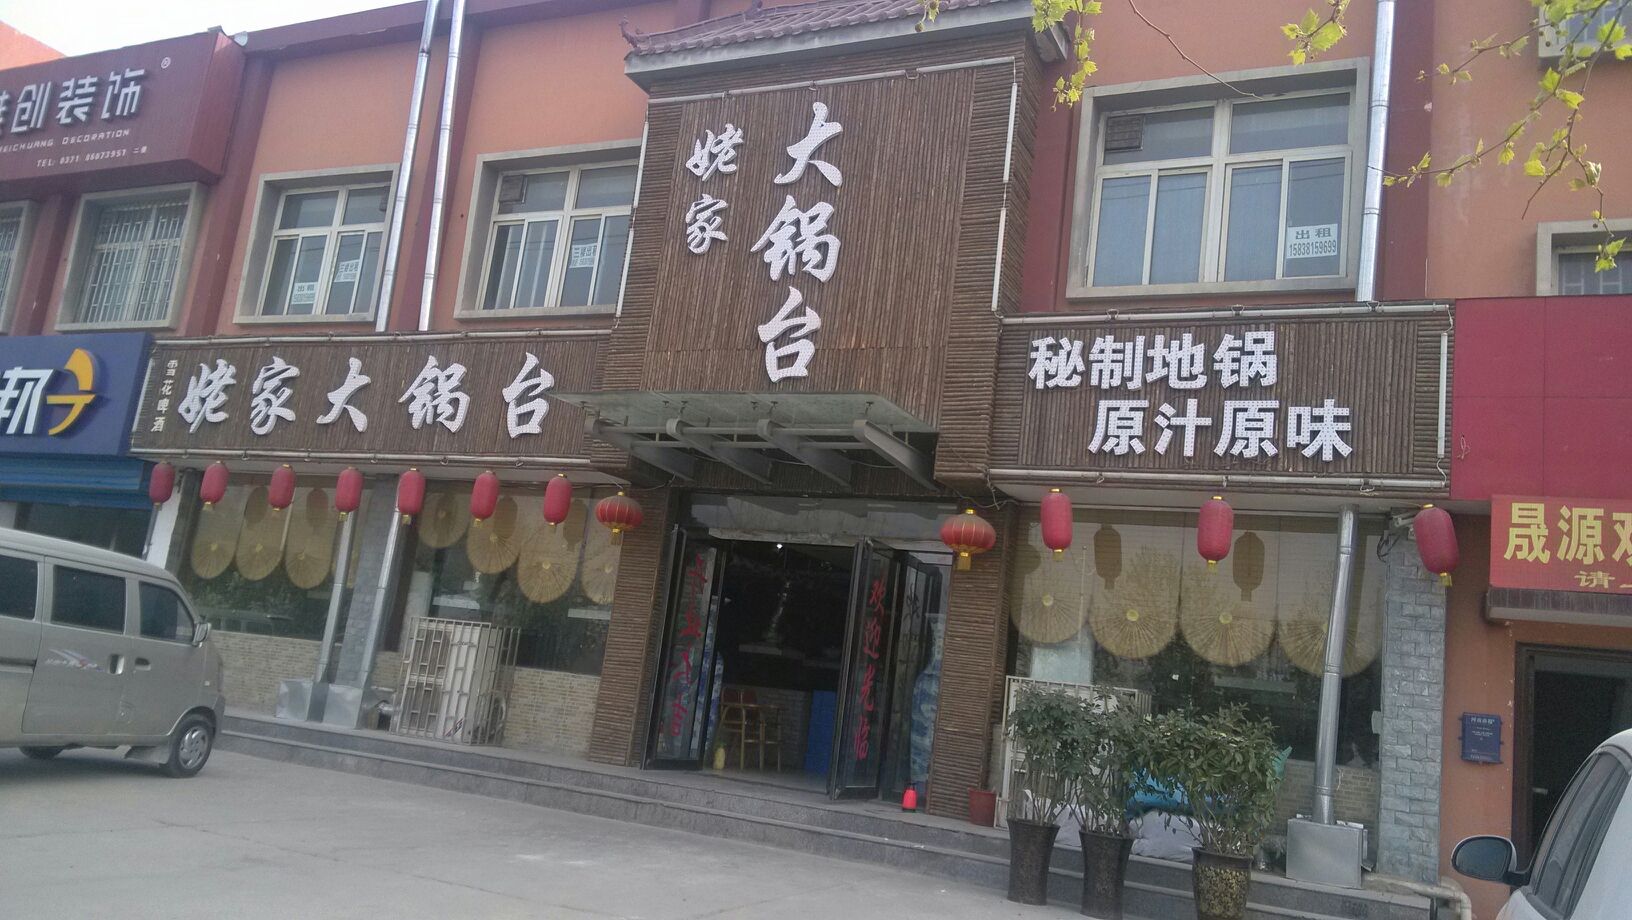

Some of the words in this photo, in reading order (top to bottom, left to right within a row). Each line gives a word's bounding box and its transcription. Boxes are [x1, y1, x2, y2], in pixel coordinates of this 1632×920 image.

[685, 122, 744, 255] 姥家
[750, 101, 844, 383] 大锅台
[1288, 239, 1338, 257] 15838159699
[1295, 226, 1332, 240] 出租
[1027, 330, 1278, 391] 秘制地锅
[150, 359, 178, 432] 雪花啤酒
[177, 351, 556, 441] 姥家大锅台
[1086, 397, 1354, 463] 原汁原味
